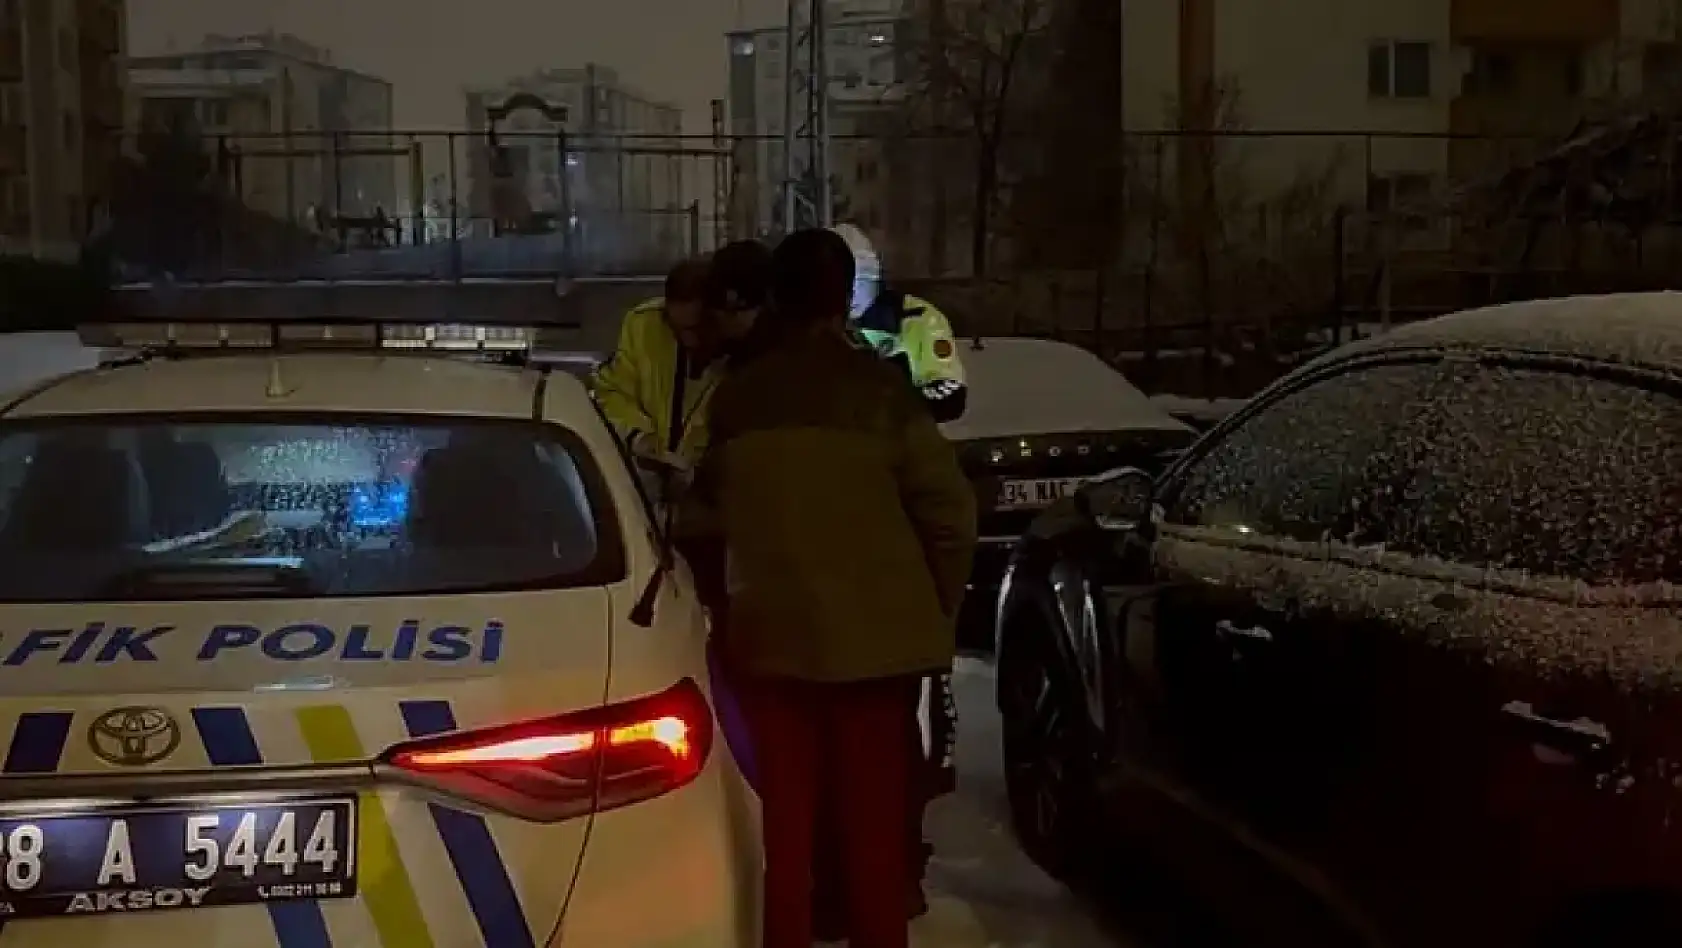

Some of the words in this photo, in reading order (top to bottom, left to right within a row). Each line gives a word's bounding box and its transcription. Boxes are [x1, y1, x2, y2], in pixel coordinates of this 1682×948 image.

[0, 621, 176, 666] FİK
[196, 620, 503, 662] POLİSİ
[0, 824, 44, 892] 8
[97, 818, 137, 886] A
[184, 810, 339, 880] 5444
[65, 886, 213, 914] AKSOY
